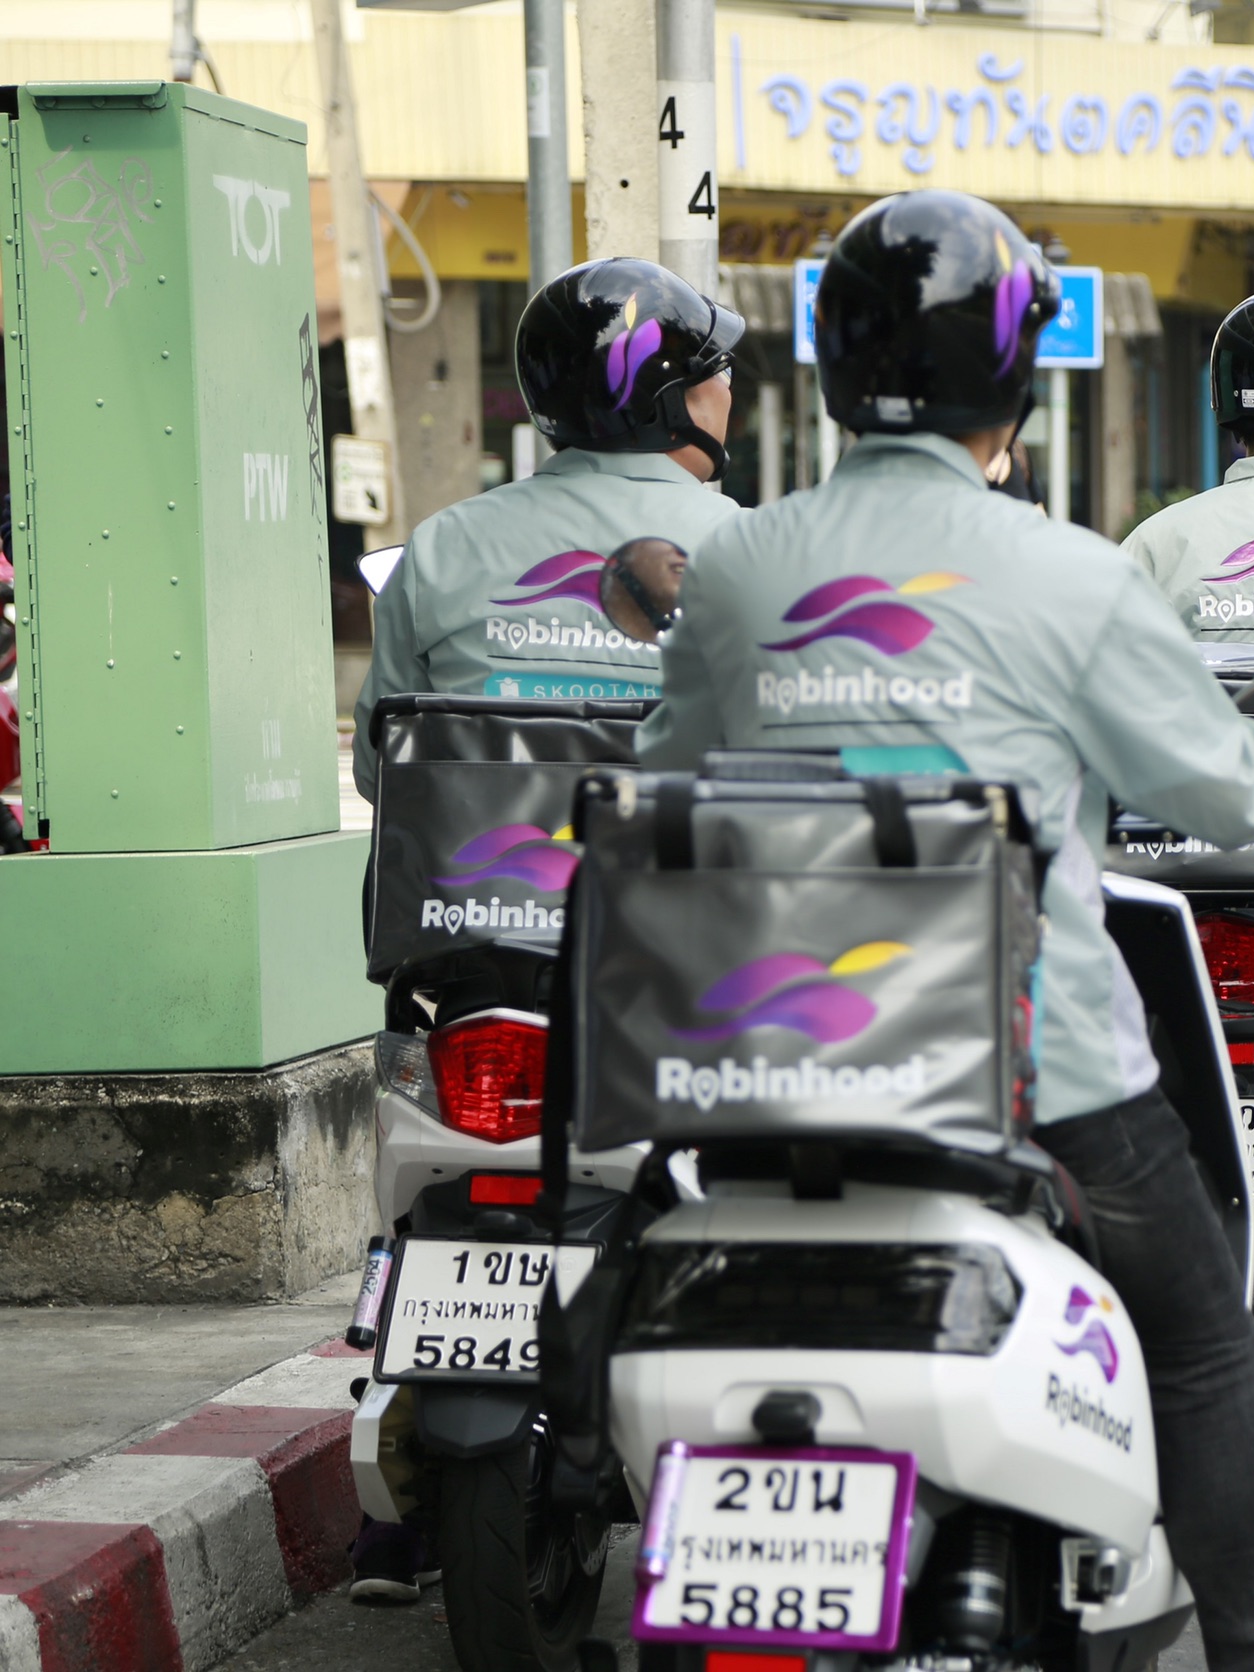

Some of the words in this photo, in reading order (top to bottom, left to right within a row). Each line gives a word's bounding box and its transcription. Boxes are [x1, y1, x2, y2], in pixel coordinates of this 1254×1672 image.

[659, 96, 685, 149] 4
[213, 174, 291, 267] TOT
[688, 170, 715, 220] 4
[243, 452, 289, 522] PTW
[486, 617, 661, 651] Robinhoo
[757, 664, 974, 716] Robinhood
[656, 1053, 926, 1112] Robinhood
[1045, 1372, 1132, 1454] Robinhood
[681, 1582, 855, 1633] 5885
